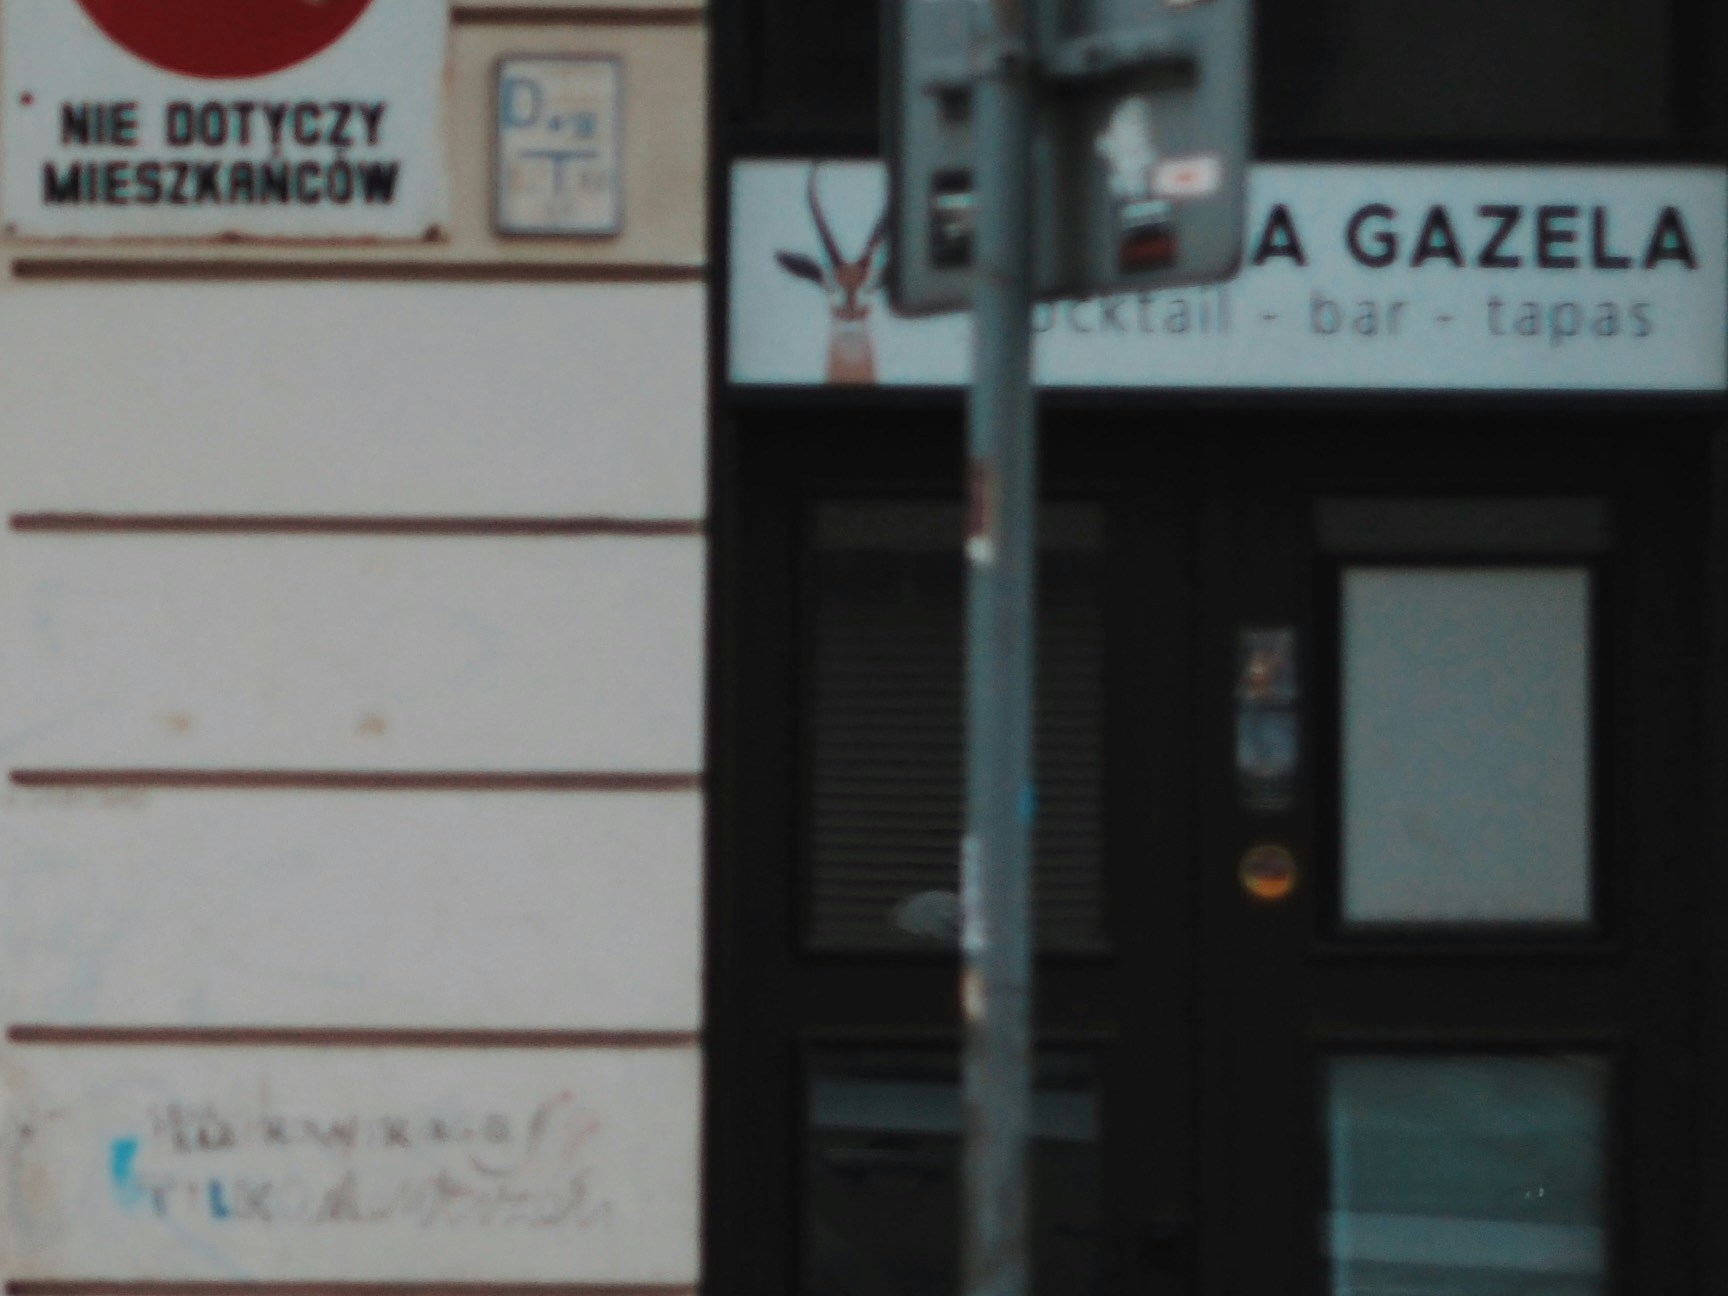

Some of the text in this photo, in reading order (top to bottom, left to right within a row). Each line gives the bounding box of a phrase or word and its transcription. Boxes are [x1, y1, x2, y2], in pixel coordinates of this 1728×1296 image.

[60, 100, 386, 150] NIE DOTYCZY
[42, 148, 401, 205] MIESZKAŃCÓW
[1250, 202, 1699, 270] A GAZELA
[1028, 286, 1230, 335] ocktail
[1308, 290, 1406, 337] bar
[1486, 294, 1656, 347] tapas
